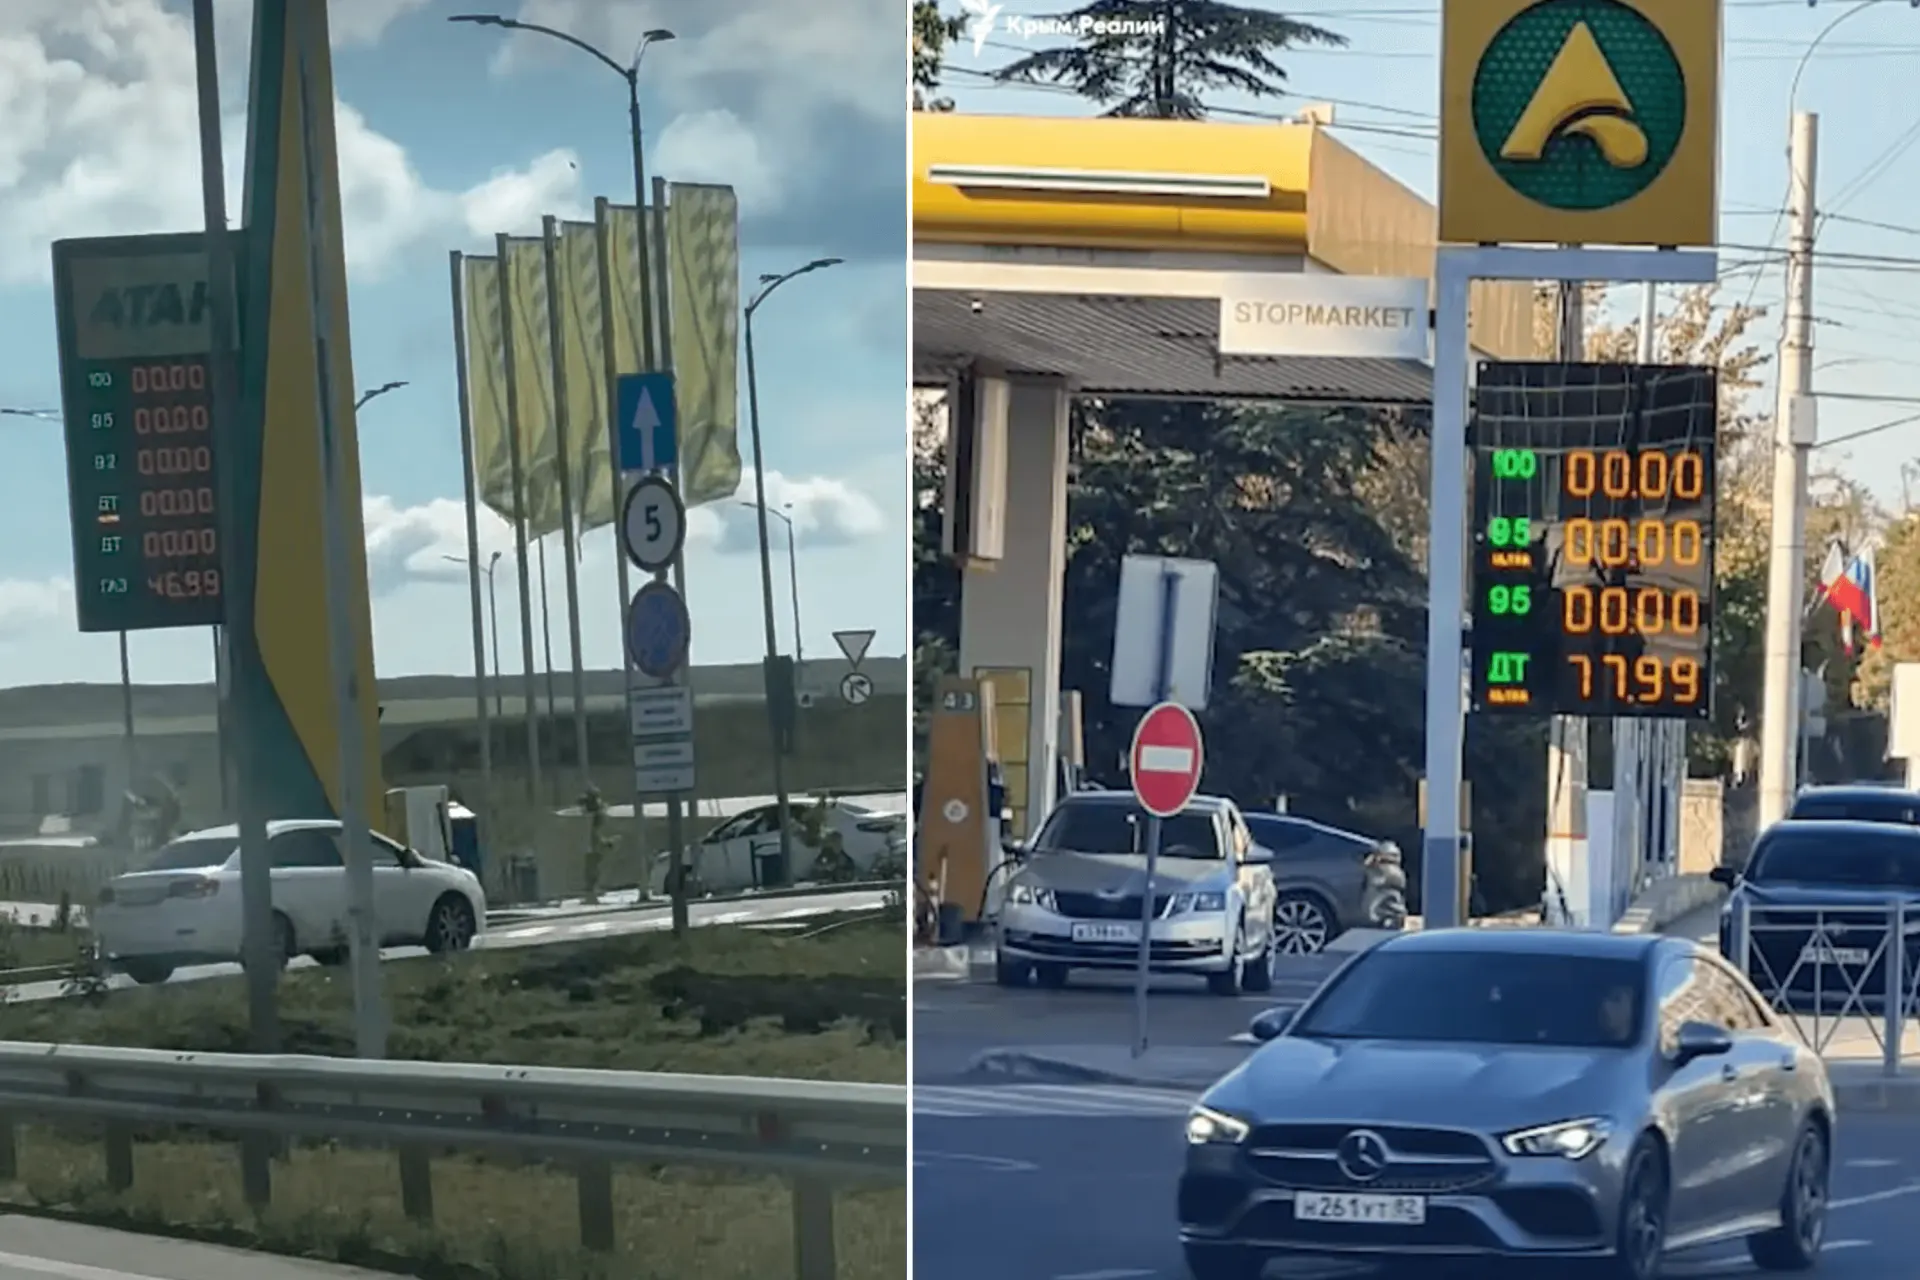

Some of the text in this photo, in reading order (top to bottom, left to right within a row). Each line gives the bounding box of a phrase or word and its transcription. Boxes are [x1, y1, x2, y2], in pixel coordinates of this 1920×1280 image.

[1235, 302, 1424, 328] STOPMARKET
[88, 372, 112, 387] 100
[91, 412, 114, 429] 95
[94, 453, 117, 470] 92
[1493, 449, 1703, 498] 100 00.00
[645, 505, 661, 542] 5
[1490, 517, 1701, 566] 95 00.00
[1489, 585, 1699, 634] 95 00.00
[1488, 652, 1698, 703] ДТ 77.99
